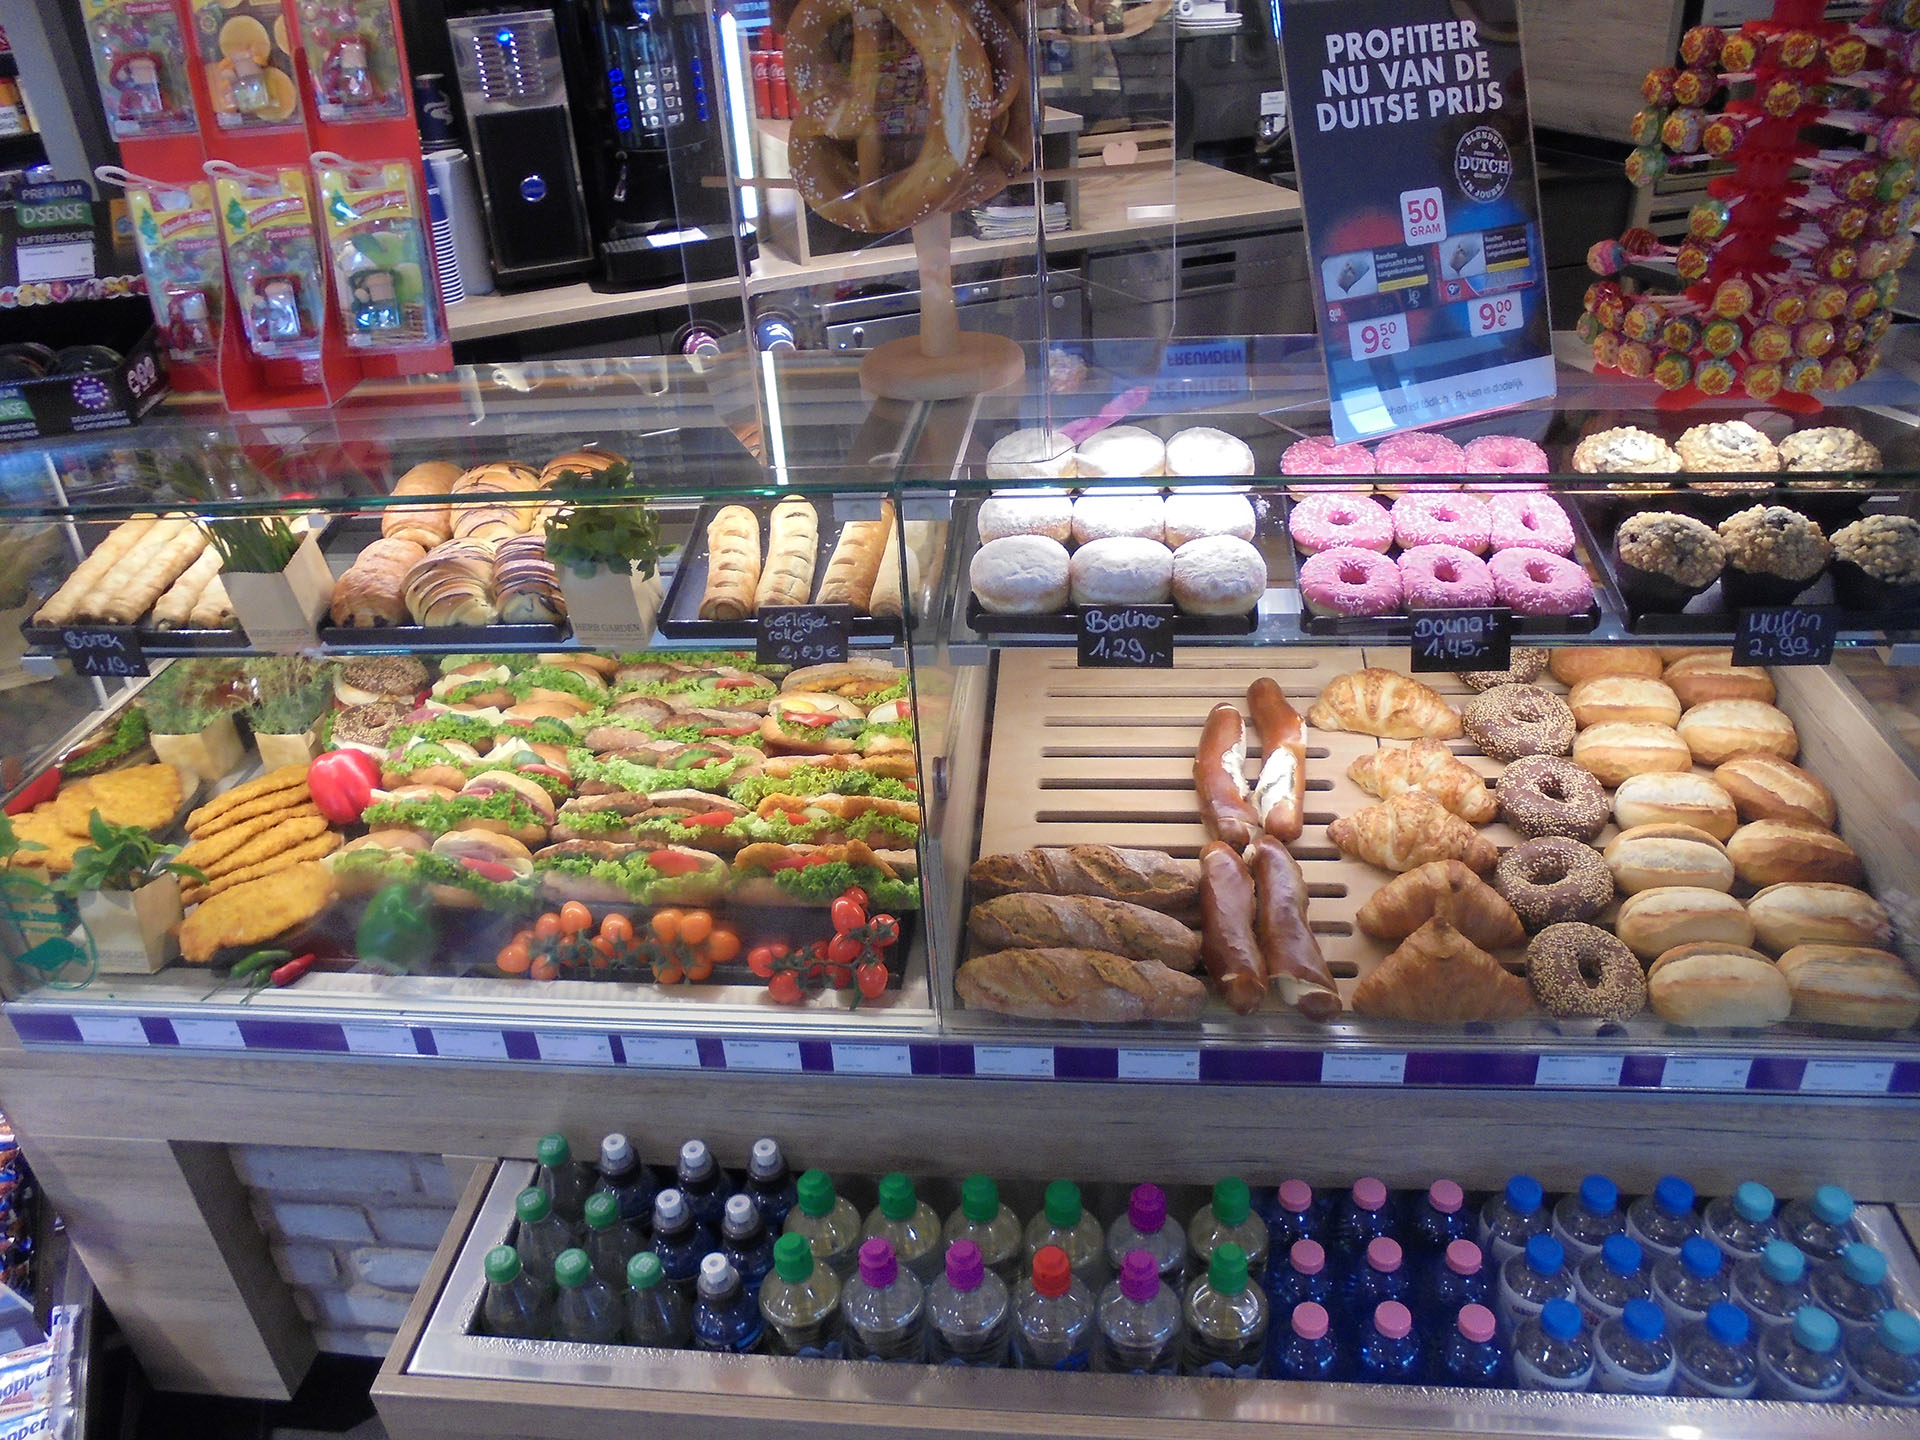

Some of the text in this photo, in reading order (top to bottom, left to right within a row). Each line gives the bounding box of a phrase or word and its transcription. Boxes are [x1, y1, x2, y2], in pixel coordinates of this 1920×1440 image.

[1325, 20, 1480, 64] PROFITEER
[1321, 51, 1490, 97] NU VAN DE
[1316, 81, 1503, 132] DUITSE PRIJS
[1465, 131, 1503, 149] BLENDED
[1459, 155, 1509, 174] DUTCH
[22, 184, 83, 200] PREMIUM
[1407, 197, 1438, 224] 50
[1410, 224, 1441, 237] GRAM
[769, 629, 803, 643] rolle
